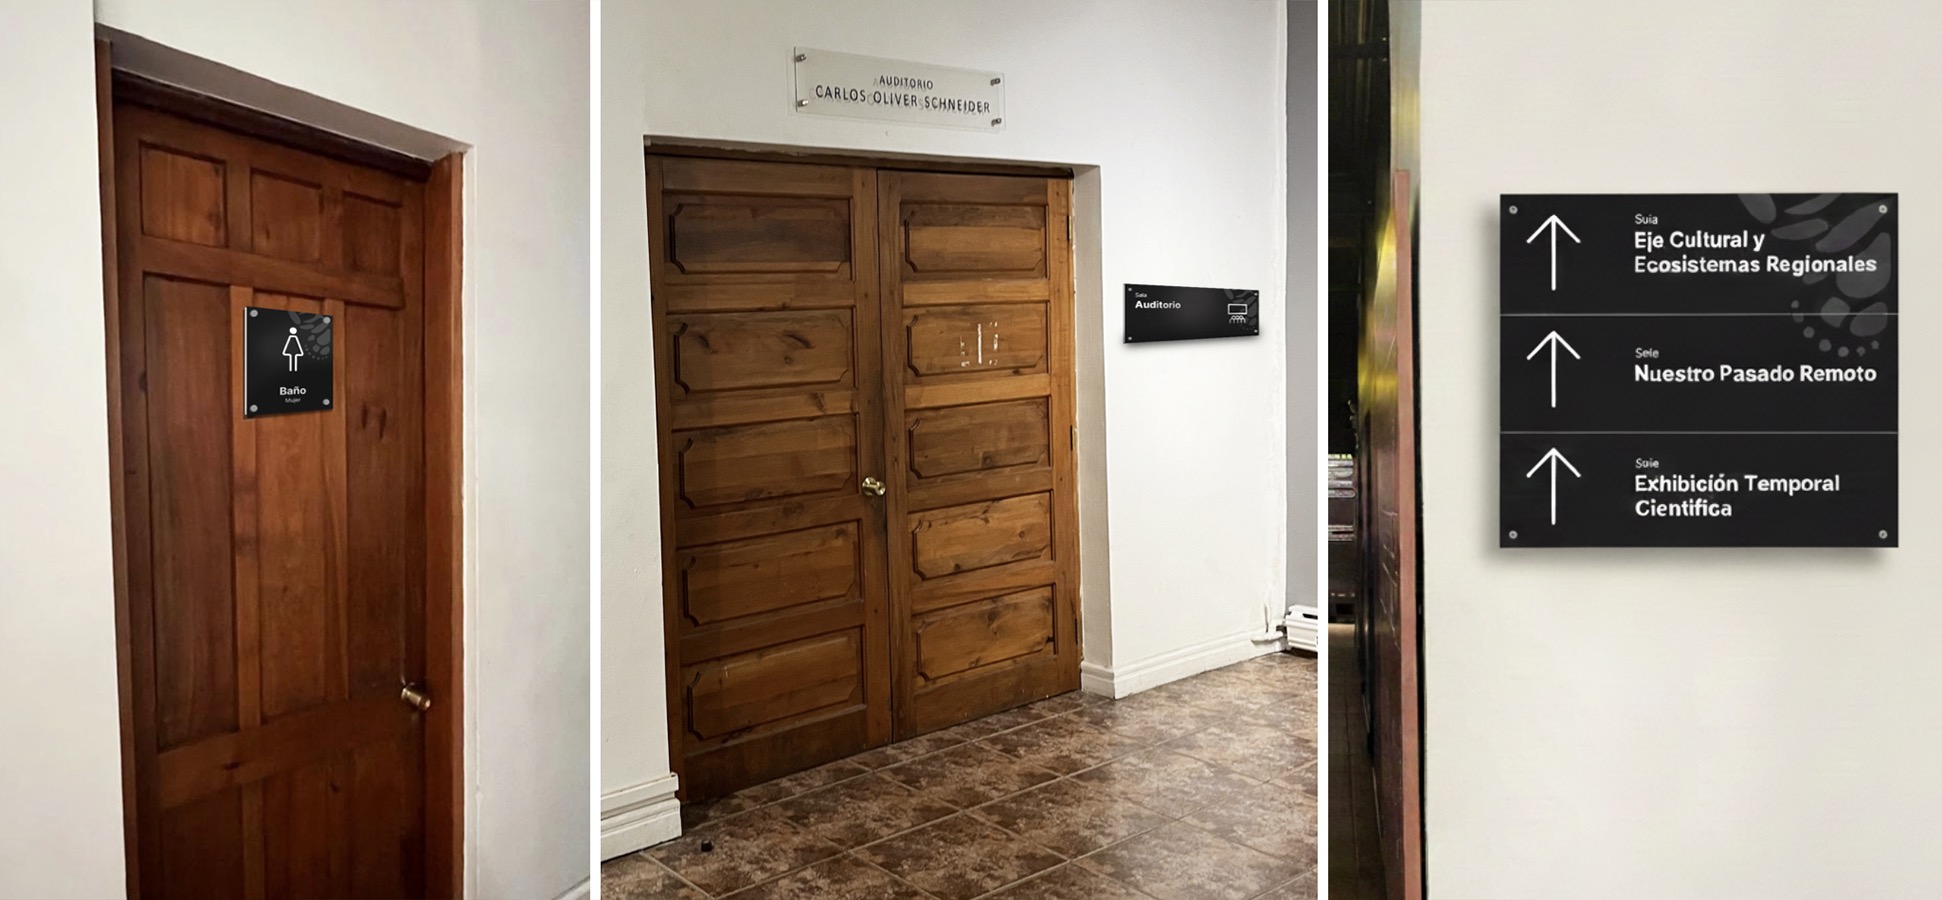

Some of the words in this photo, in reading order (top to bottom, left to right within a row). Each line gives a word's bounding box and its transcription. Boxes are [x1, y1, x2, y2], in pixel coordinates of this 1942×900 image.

[879, 75, 933, 90] AUDITORIO
[815, 85, 866, 102] CARLOS
[873, 91, 917, 107] OLIVER
[924, 96, 990, 113] SCHNEIDER
[1634, 231, 1664, 252] Eje
[1669, 230, 1748, 248] Cultural
[1753, 233, 1765, 252] y
[1634, 254, 1760, 273] Ecosistemas
[1766, 255, 1877, 277] Regionales
[1135, 300, 1181, 309] Auditorio
[1634, 364, 1715, 382] Nuestro
[1719, 364, 1795, 382] Pasado
[1799, 365, 1877, 382] Remoto
[279, 386, 307, 396] Baño
[1634, 473, 1739, 492] Exhibición
[1744, 474, 1840, 496] Temporal
